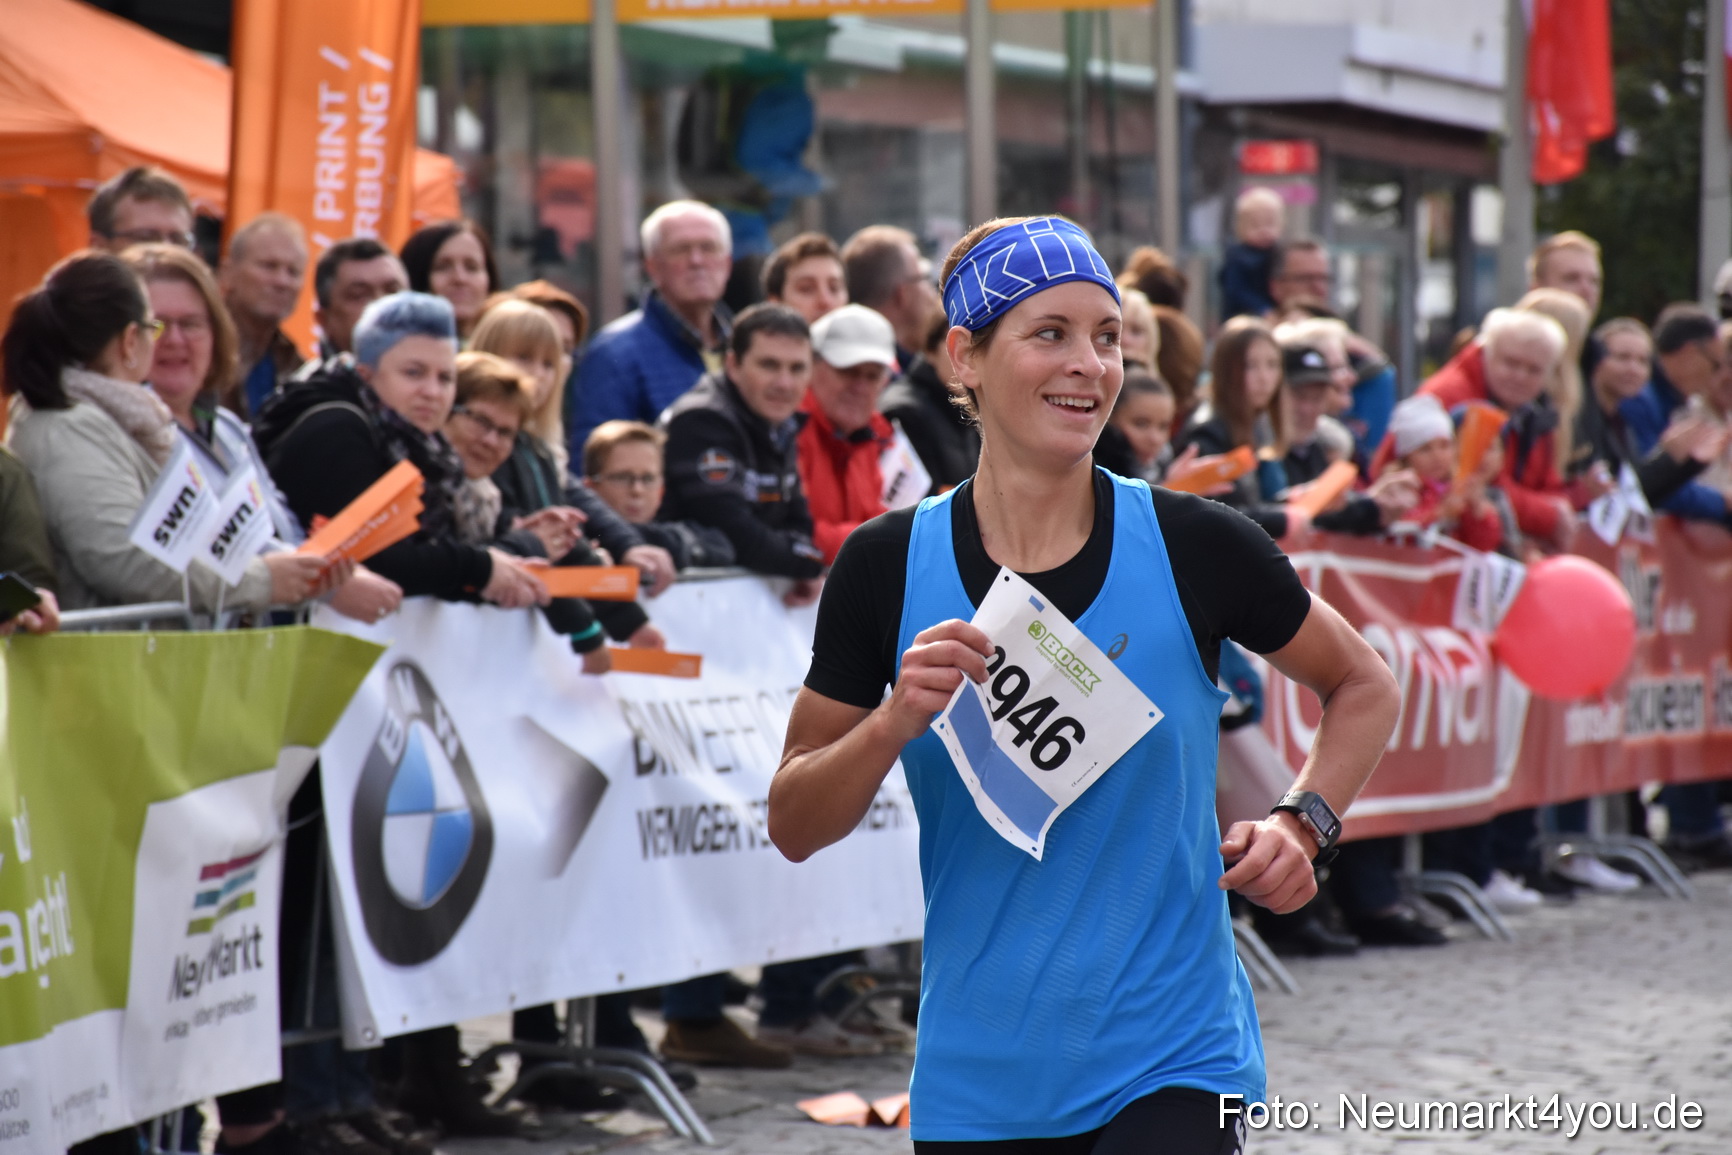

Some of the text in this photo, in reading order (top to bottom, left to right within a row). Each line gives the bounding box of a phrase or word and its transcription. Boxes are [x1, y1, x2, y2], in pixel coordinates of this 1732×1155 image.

[313, 81, 348, 222] PRINT
[352, 82, 391, 241] RBUNG
[153, 485, 197, 548] swn
[210, 501, 253, 561] swn
[1039, 632, 1102, 693] BOCK
[1069, 678, 1090, 699] concepts
